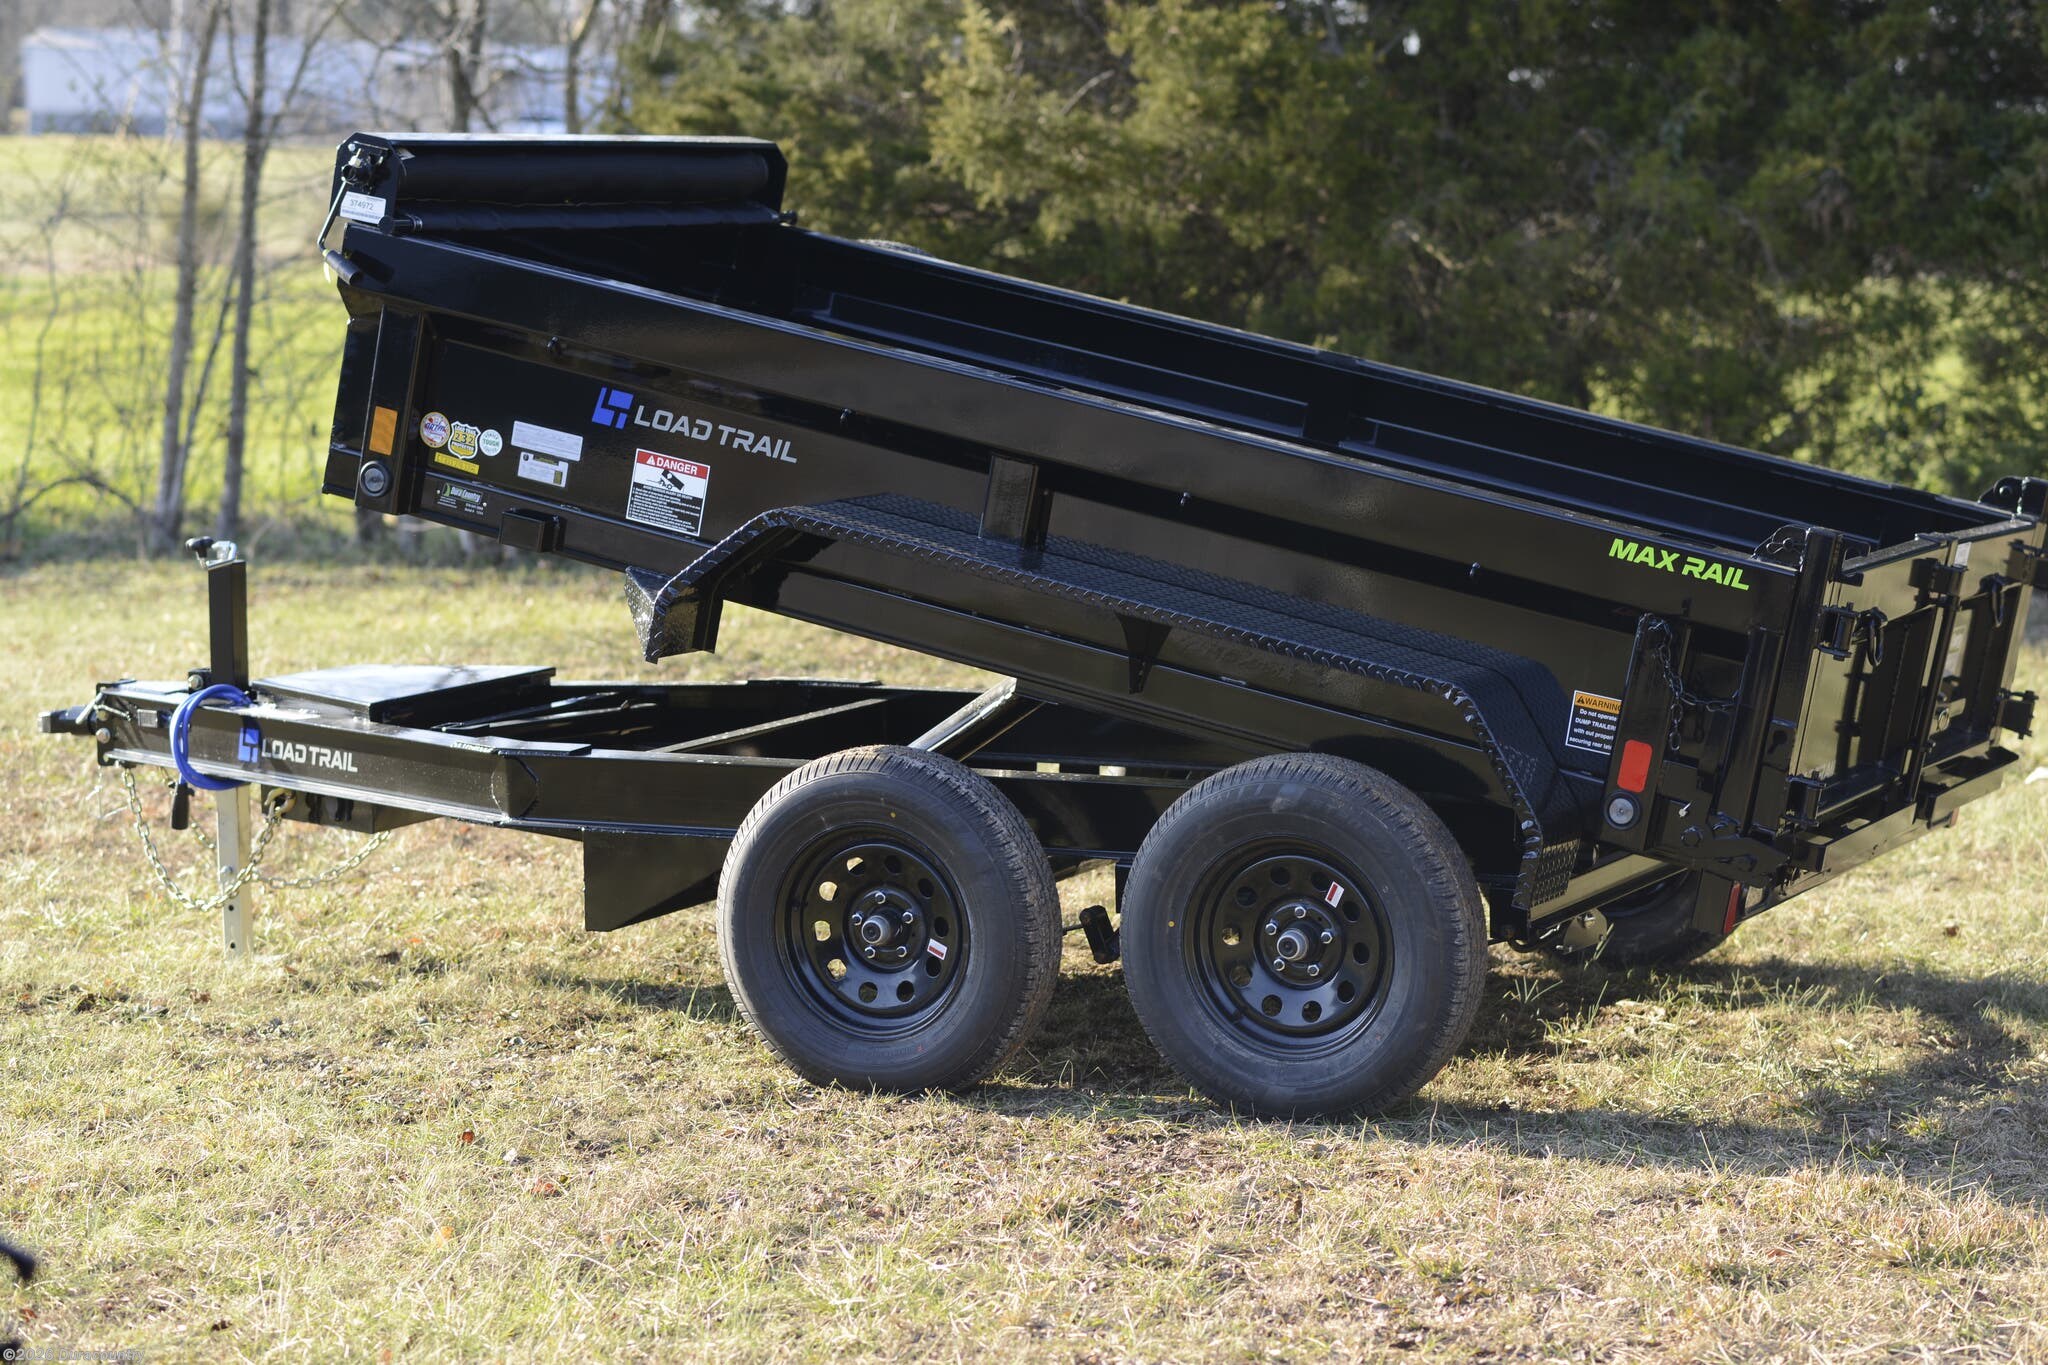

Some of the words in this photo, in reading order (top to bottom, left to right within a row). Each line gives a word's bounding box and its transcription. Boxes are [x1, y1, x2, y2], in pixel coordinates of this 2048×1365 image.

[634, 405, 713, 441] LOAD
[718, 424, 797, 464] TRAIL
[656, 457, 698, 475] DANGER
[1608, 538, 1680, 573] MAX
[1681, 556, 1750, 591] RAIL
[1575, 717, 1591, 726] DUMP
[1597, 713, 1617, 722] operate
[1569, 737, 1592, 747] securing
[261, 739, 307, 763] LOAD
[309, 745, 358, 773] TRAIL
